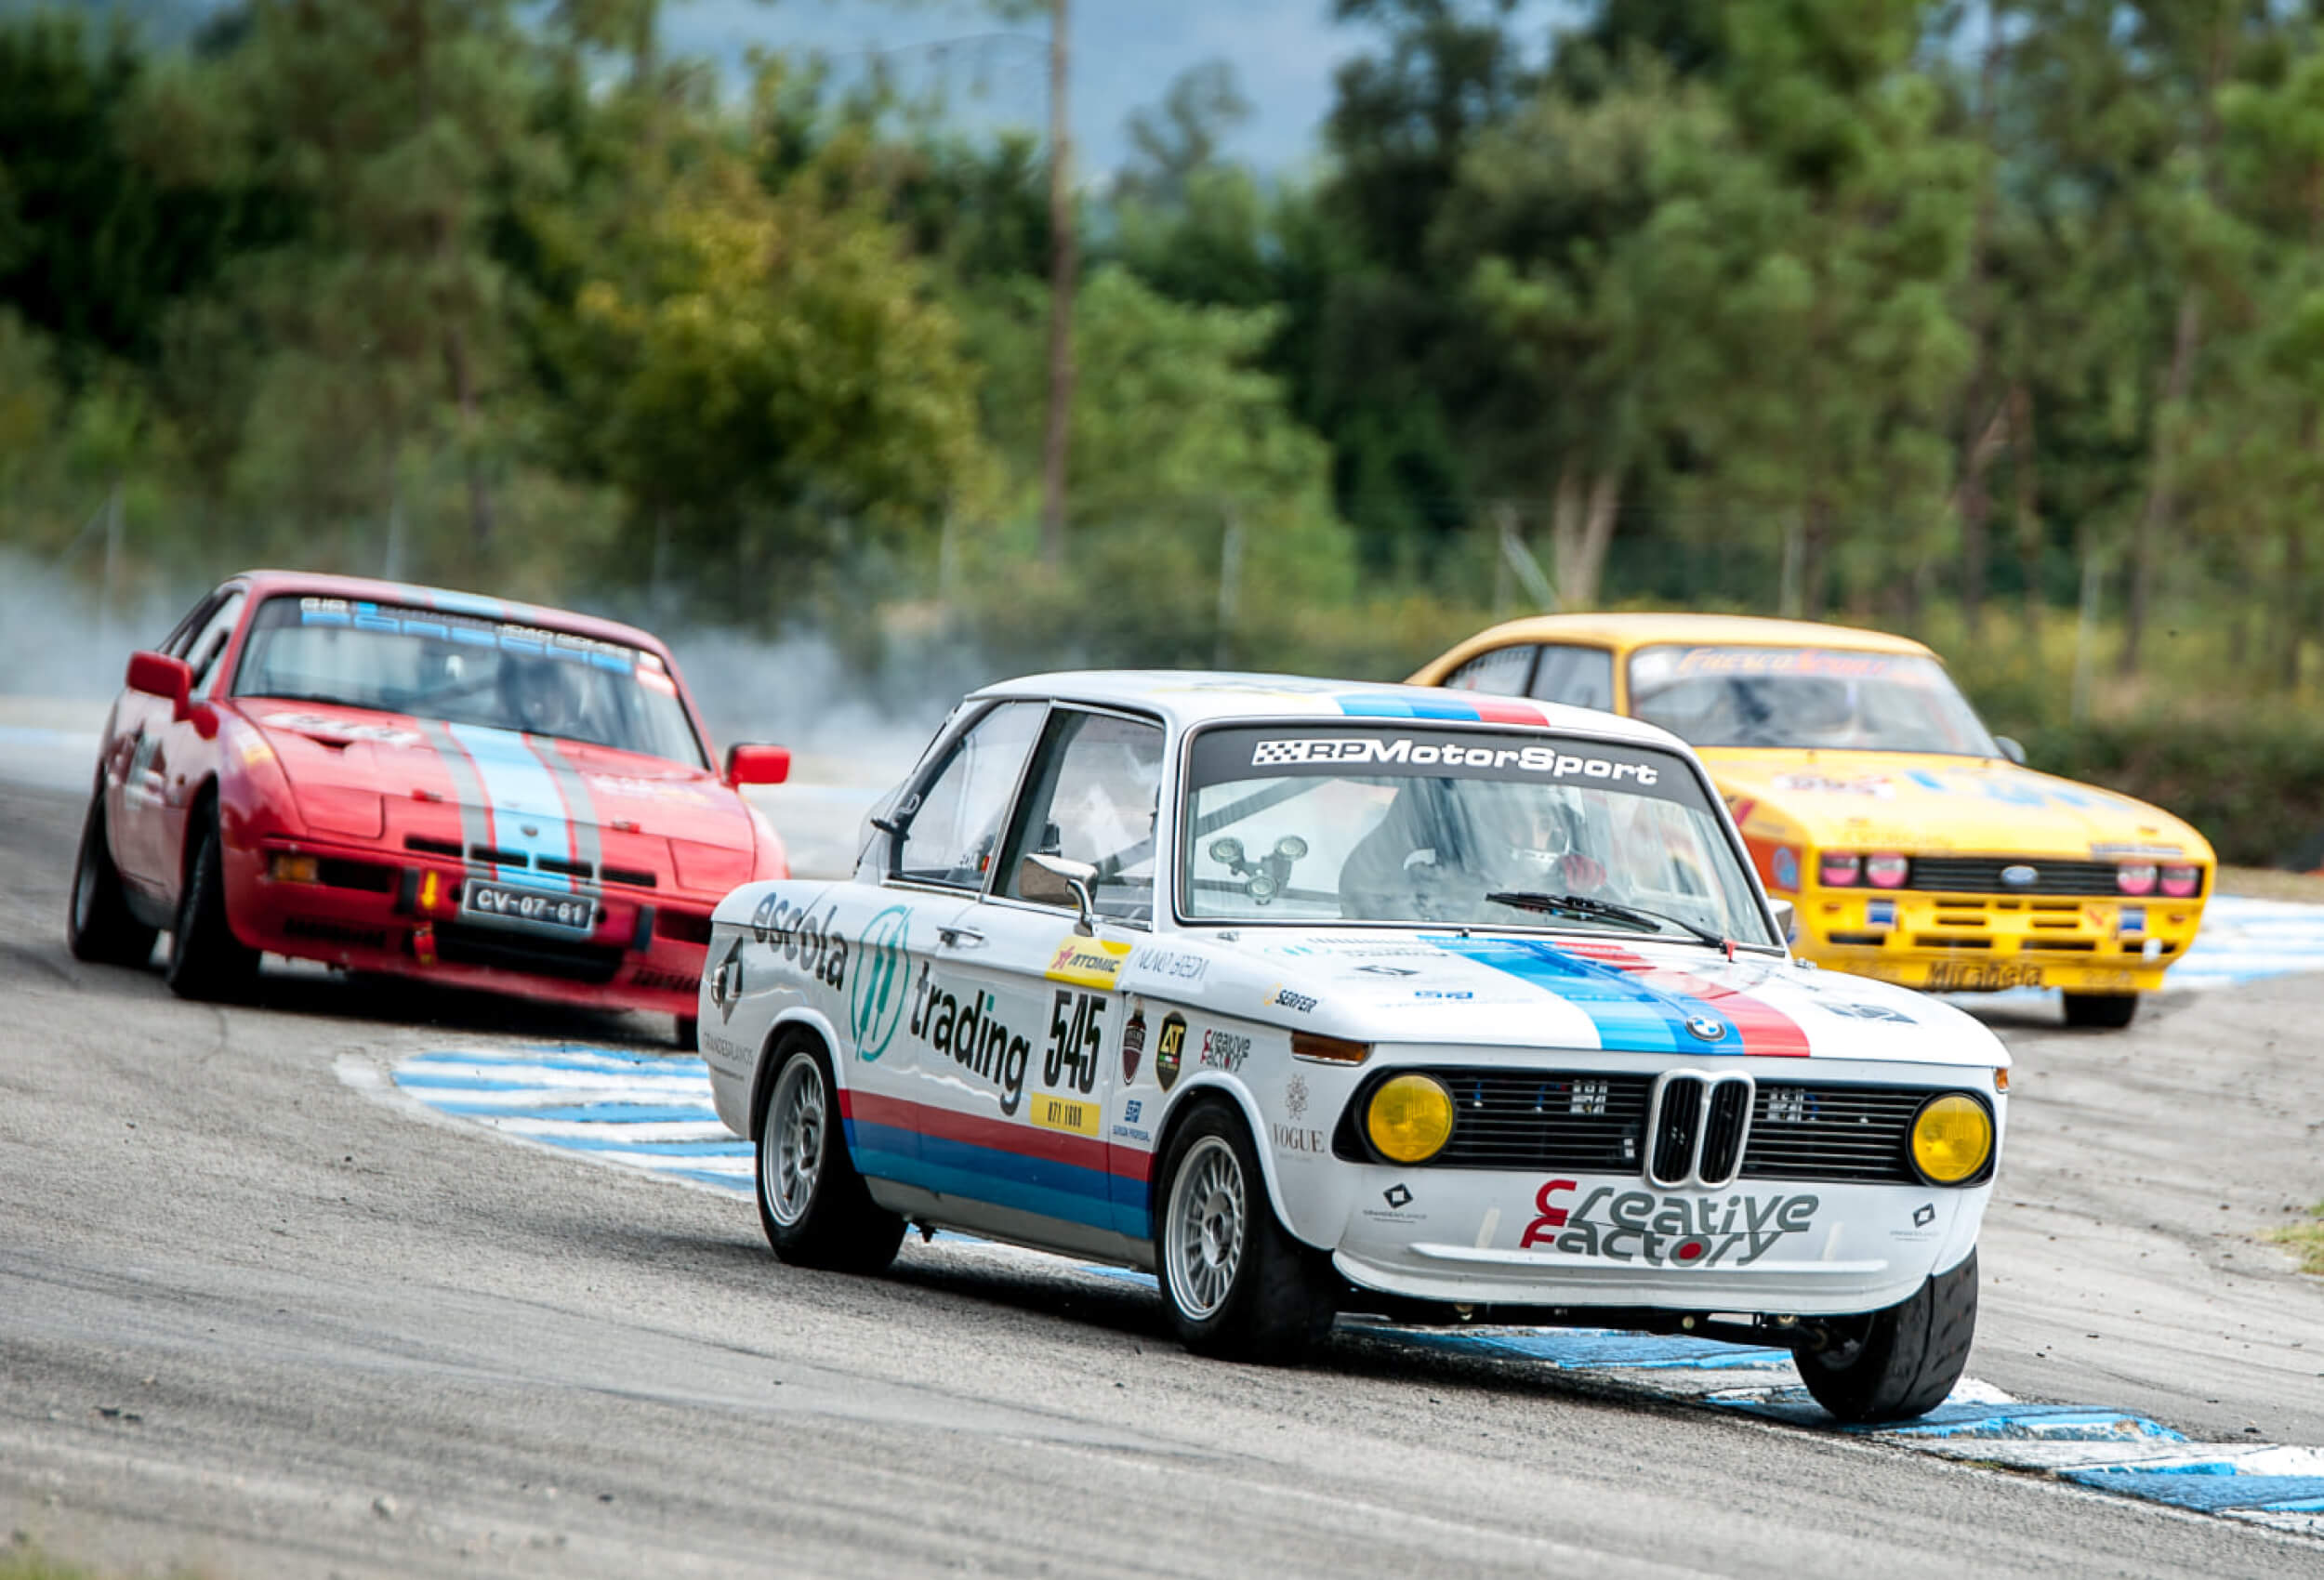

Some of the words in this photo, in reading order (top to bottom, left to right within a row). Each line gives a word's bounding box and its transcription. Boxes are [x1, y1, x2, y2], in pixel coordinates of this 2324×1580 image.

[476, 889, 584, 924] CV-07-61
[751, 891, 848, 992] escola
[1069, 953, 1121, 973] ATOMIC
[910, 960, 1030, 1116] trading
[1044, 989, 1107, 1094] 545
[1273, 1123, 1326, 1153] VOGUE
